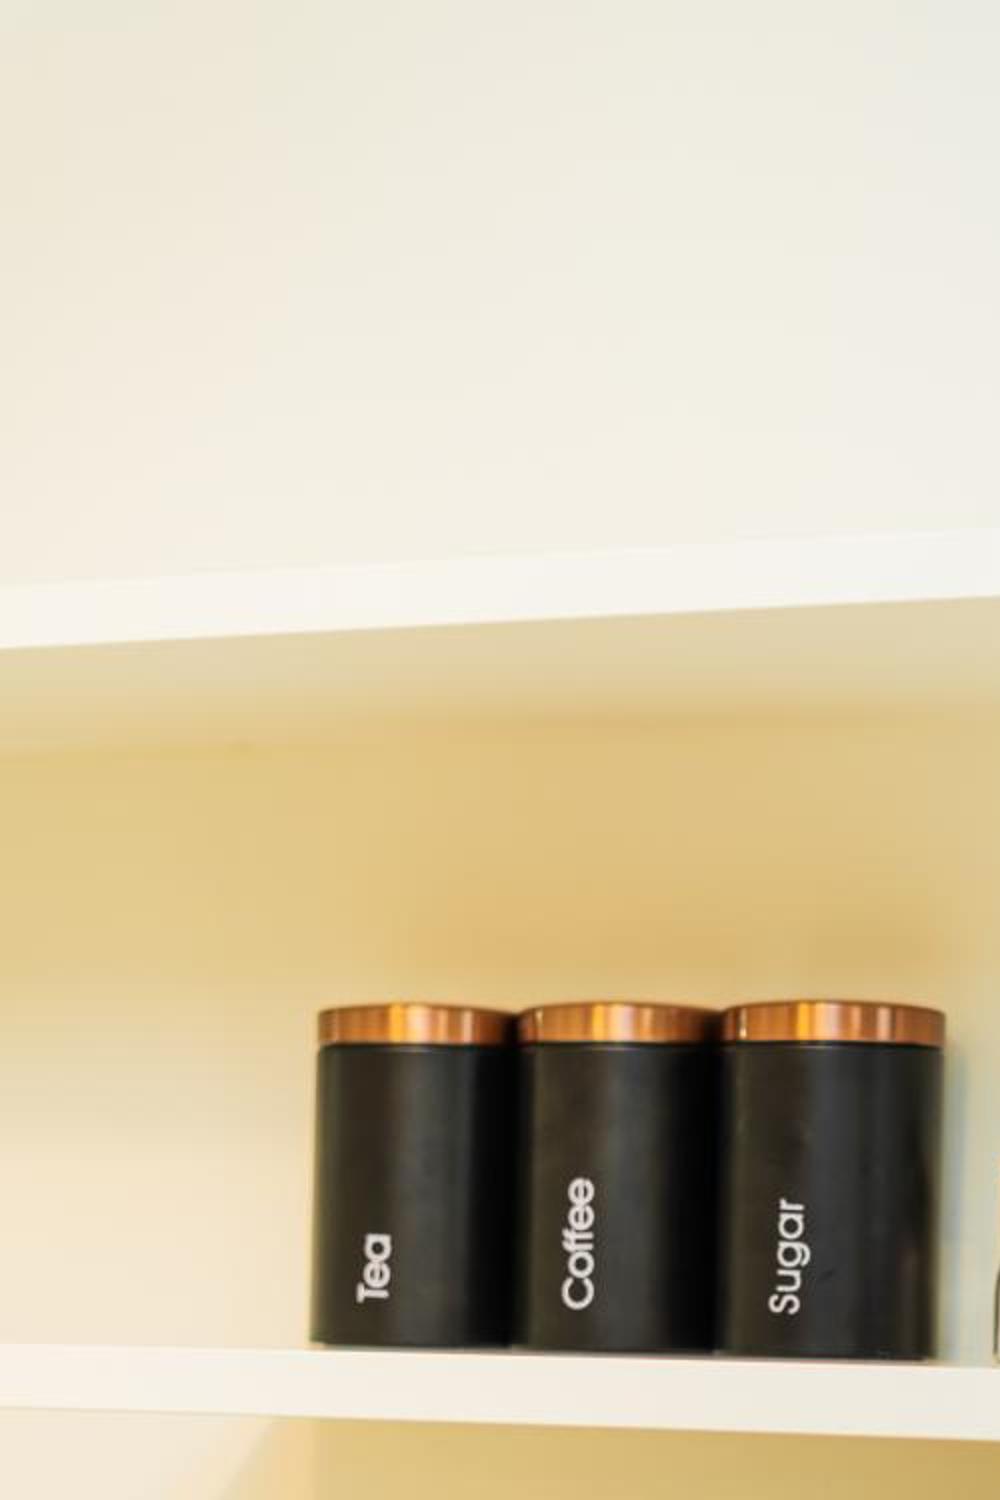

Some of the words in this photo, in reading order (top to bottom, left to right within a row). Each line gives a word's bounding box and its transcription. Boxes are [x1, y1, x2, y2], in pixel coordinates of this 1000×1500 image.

[357, 1233, 392, 1303] Tea
[562, 1178, 595, 1310] Coffee
[768, 1198, 811, 1315] Sugar
